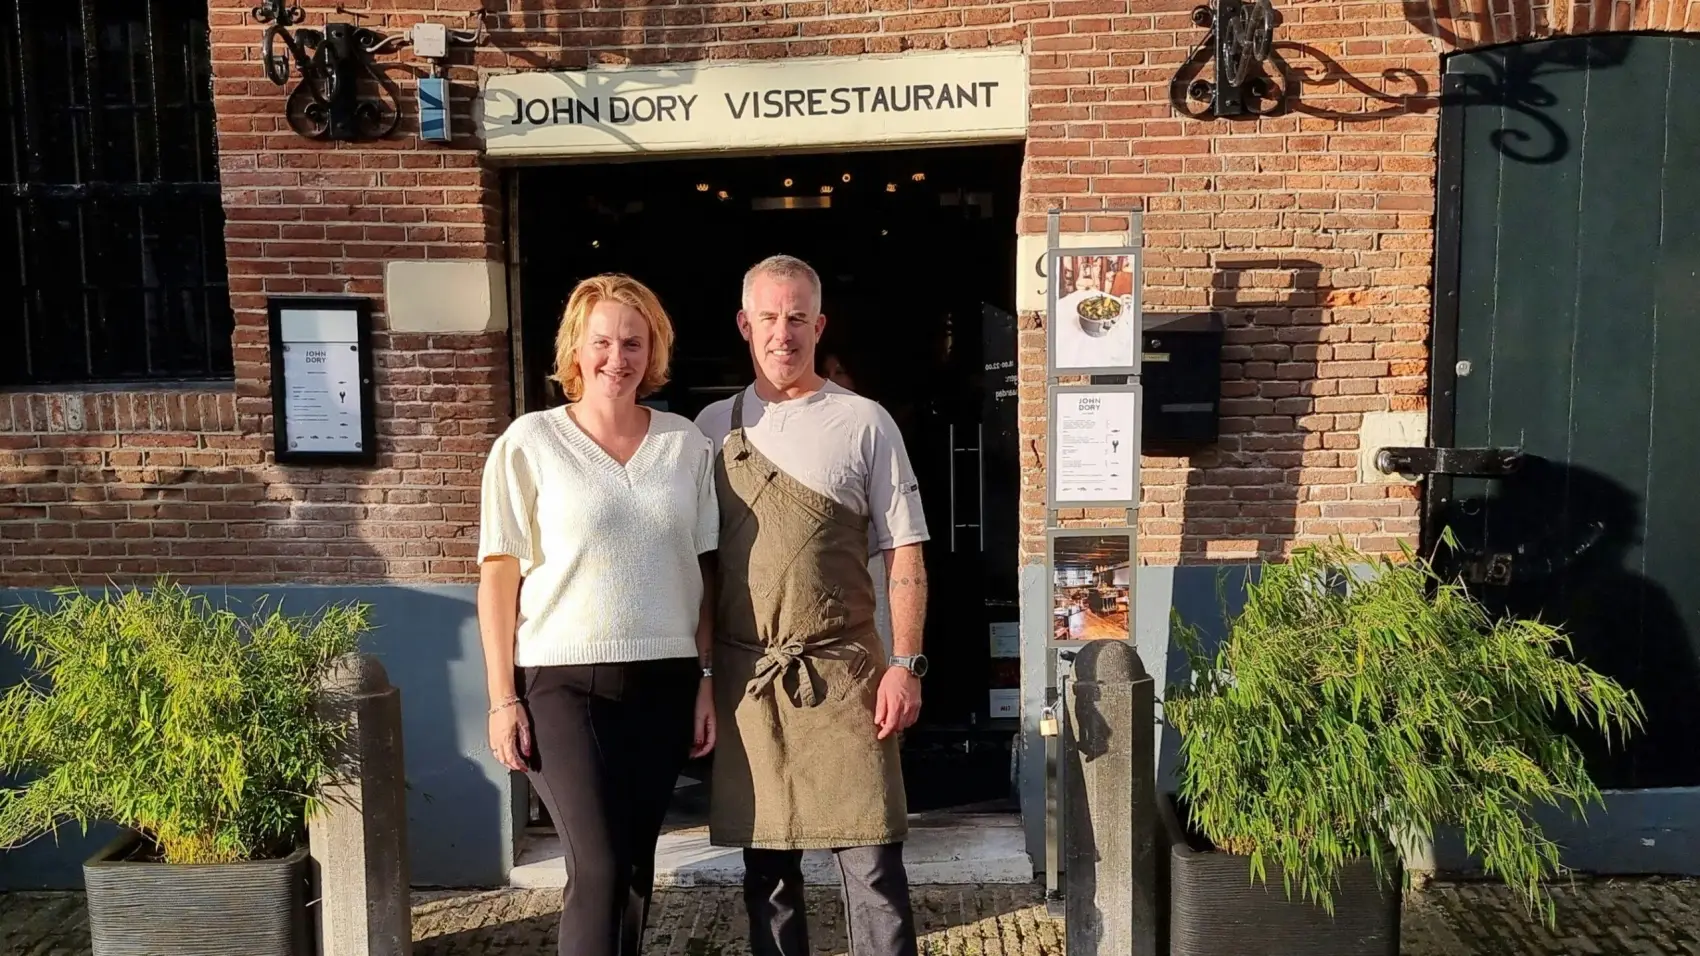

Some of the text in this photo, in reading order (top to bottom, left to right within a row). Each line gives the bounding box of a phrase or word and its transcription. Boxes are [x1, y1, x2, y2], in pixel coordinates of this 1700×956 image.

[511, 81, 999, 126] JOHN DORY VISRESTAURANT
